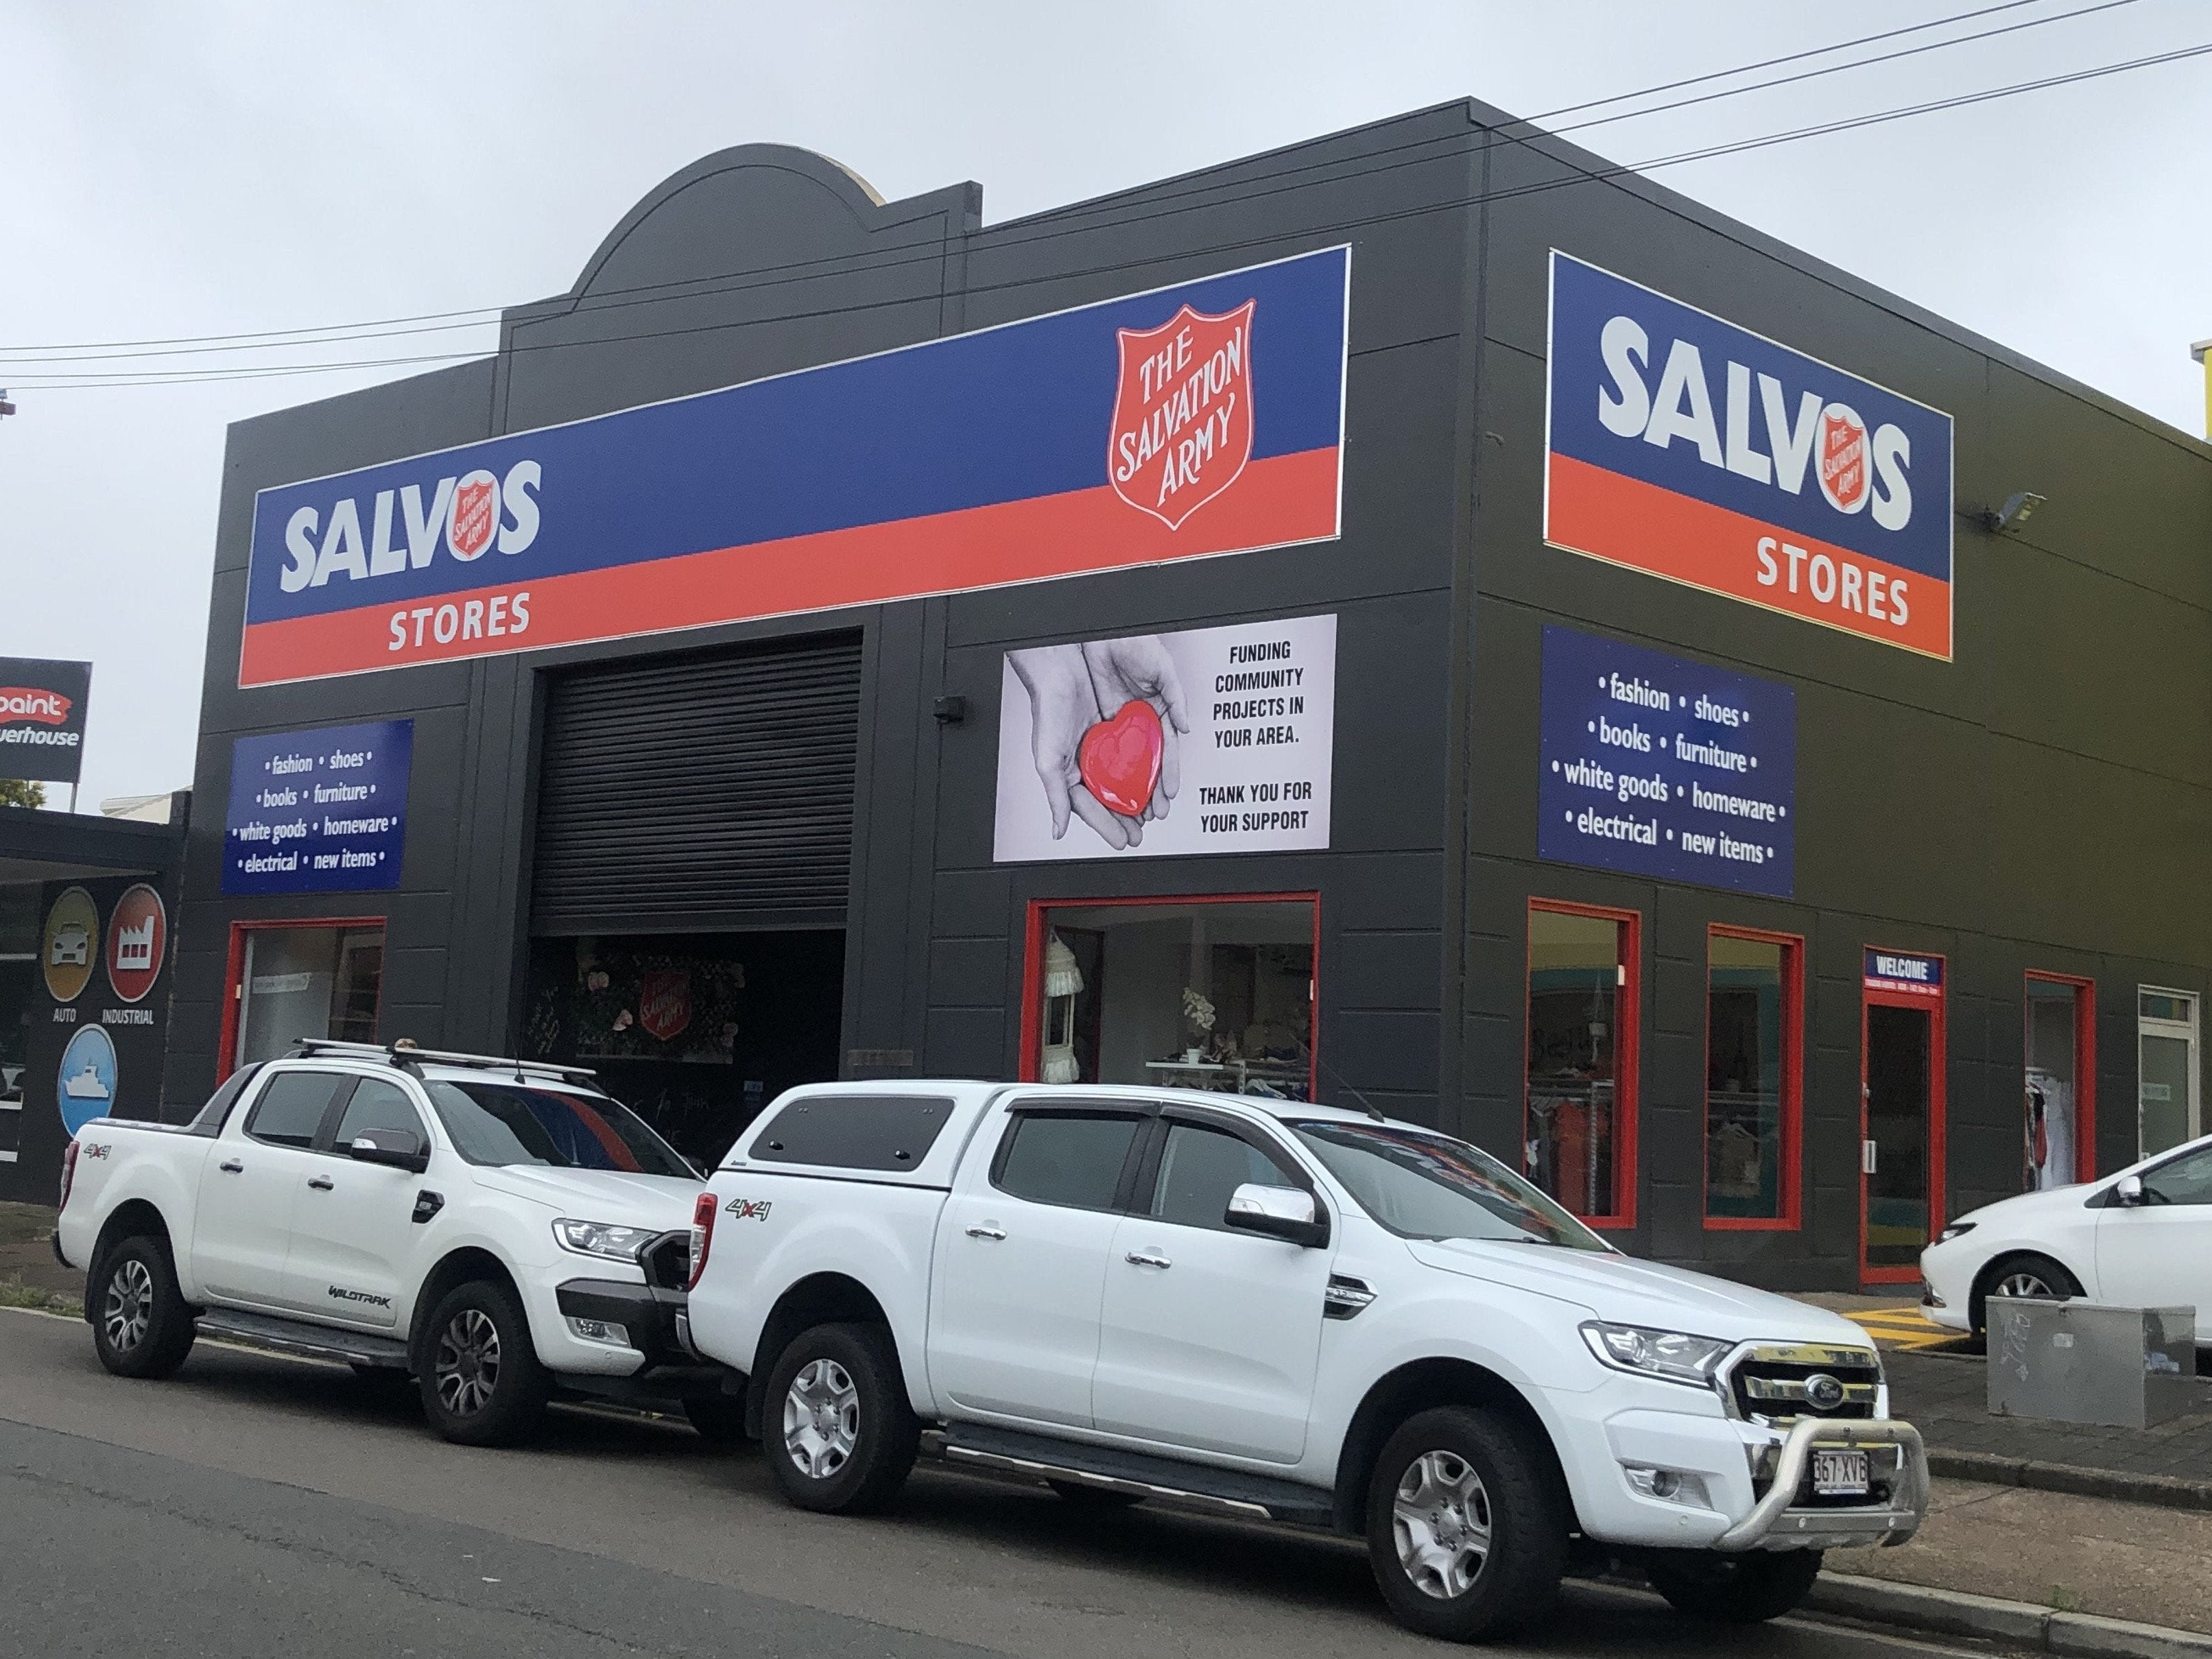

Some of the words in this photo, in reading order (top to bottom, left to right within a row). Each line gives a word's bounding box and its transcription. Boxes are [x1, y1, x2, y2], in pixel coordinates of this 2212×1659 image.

[1139, 324, 1193, 404] THE
[1117, 326, 1241, 481] SALVATION
[1599, 315, 1912, 531] SALVOS
[1157, 392, 1235, 508] ARMY
[280, 460, 541, 593] SALVOS
[1757, 536, 1909, 625] STORES
[388, 593, 530, 651] STORES
[1229, 641, 1291, 664] FUNDING
[1215, 667, 1304, 693] COMMUNITY
[1213, 697, 1284, 721] PROJECTS
[1289, 696, 1303, 715] IN
[1610, 672, 1670, 711] fashion
[1694, 694, 1739, 727] shoes
[1215, 728, 1252, 748] YOUR
[1257, 726, 1299, 745] AREA.
[1599, 715, 1651, 752] books
[1676, 733, 1747, 773] furniture
[272, 754, 313, 774] fashion
[330, 749, 364, 769] shoes
[263, 787, 297, 807] books
[314, 781, 368, 803] furniture
[1200, 785, 1245, 805] THANK
[1250, 783, 1279, 802] YOU
[1283, 781, 1312, 801] FOR
[1564, 758, 1613, 791] white
[1618, 774, 1668, 802] goods
[1693, 781, 1776, 822] homeware
[240, 821, 270, 841] white
[272, 817, 307, 845] goods
[324, 815, 388, 835] homeware
[1200, 814, 1237, 833] YOUR
[1242, 811, 1309, 831] SUPPORT
[1577, 807, 1657, 846] electrical
[1682, 830, 1715, 855] new
[1720, 831, 1763, 863] items
[245, 850, 298, 873] electrical
[314, 854, 340, 869] new
[341, 848, 377, 868] items
[1876, 955, 1928, 980] WELCOME
[53, 1008, 76, 1022] AUTO
[102, 1009, 154, 1025] INDUSTRIAL
[328, 1285, 391, 1309] WILDTRAK
